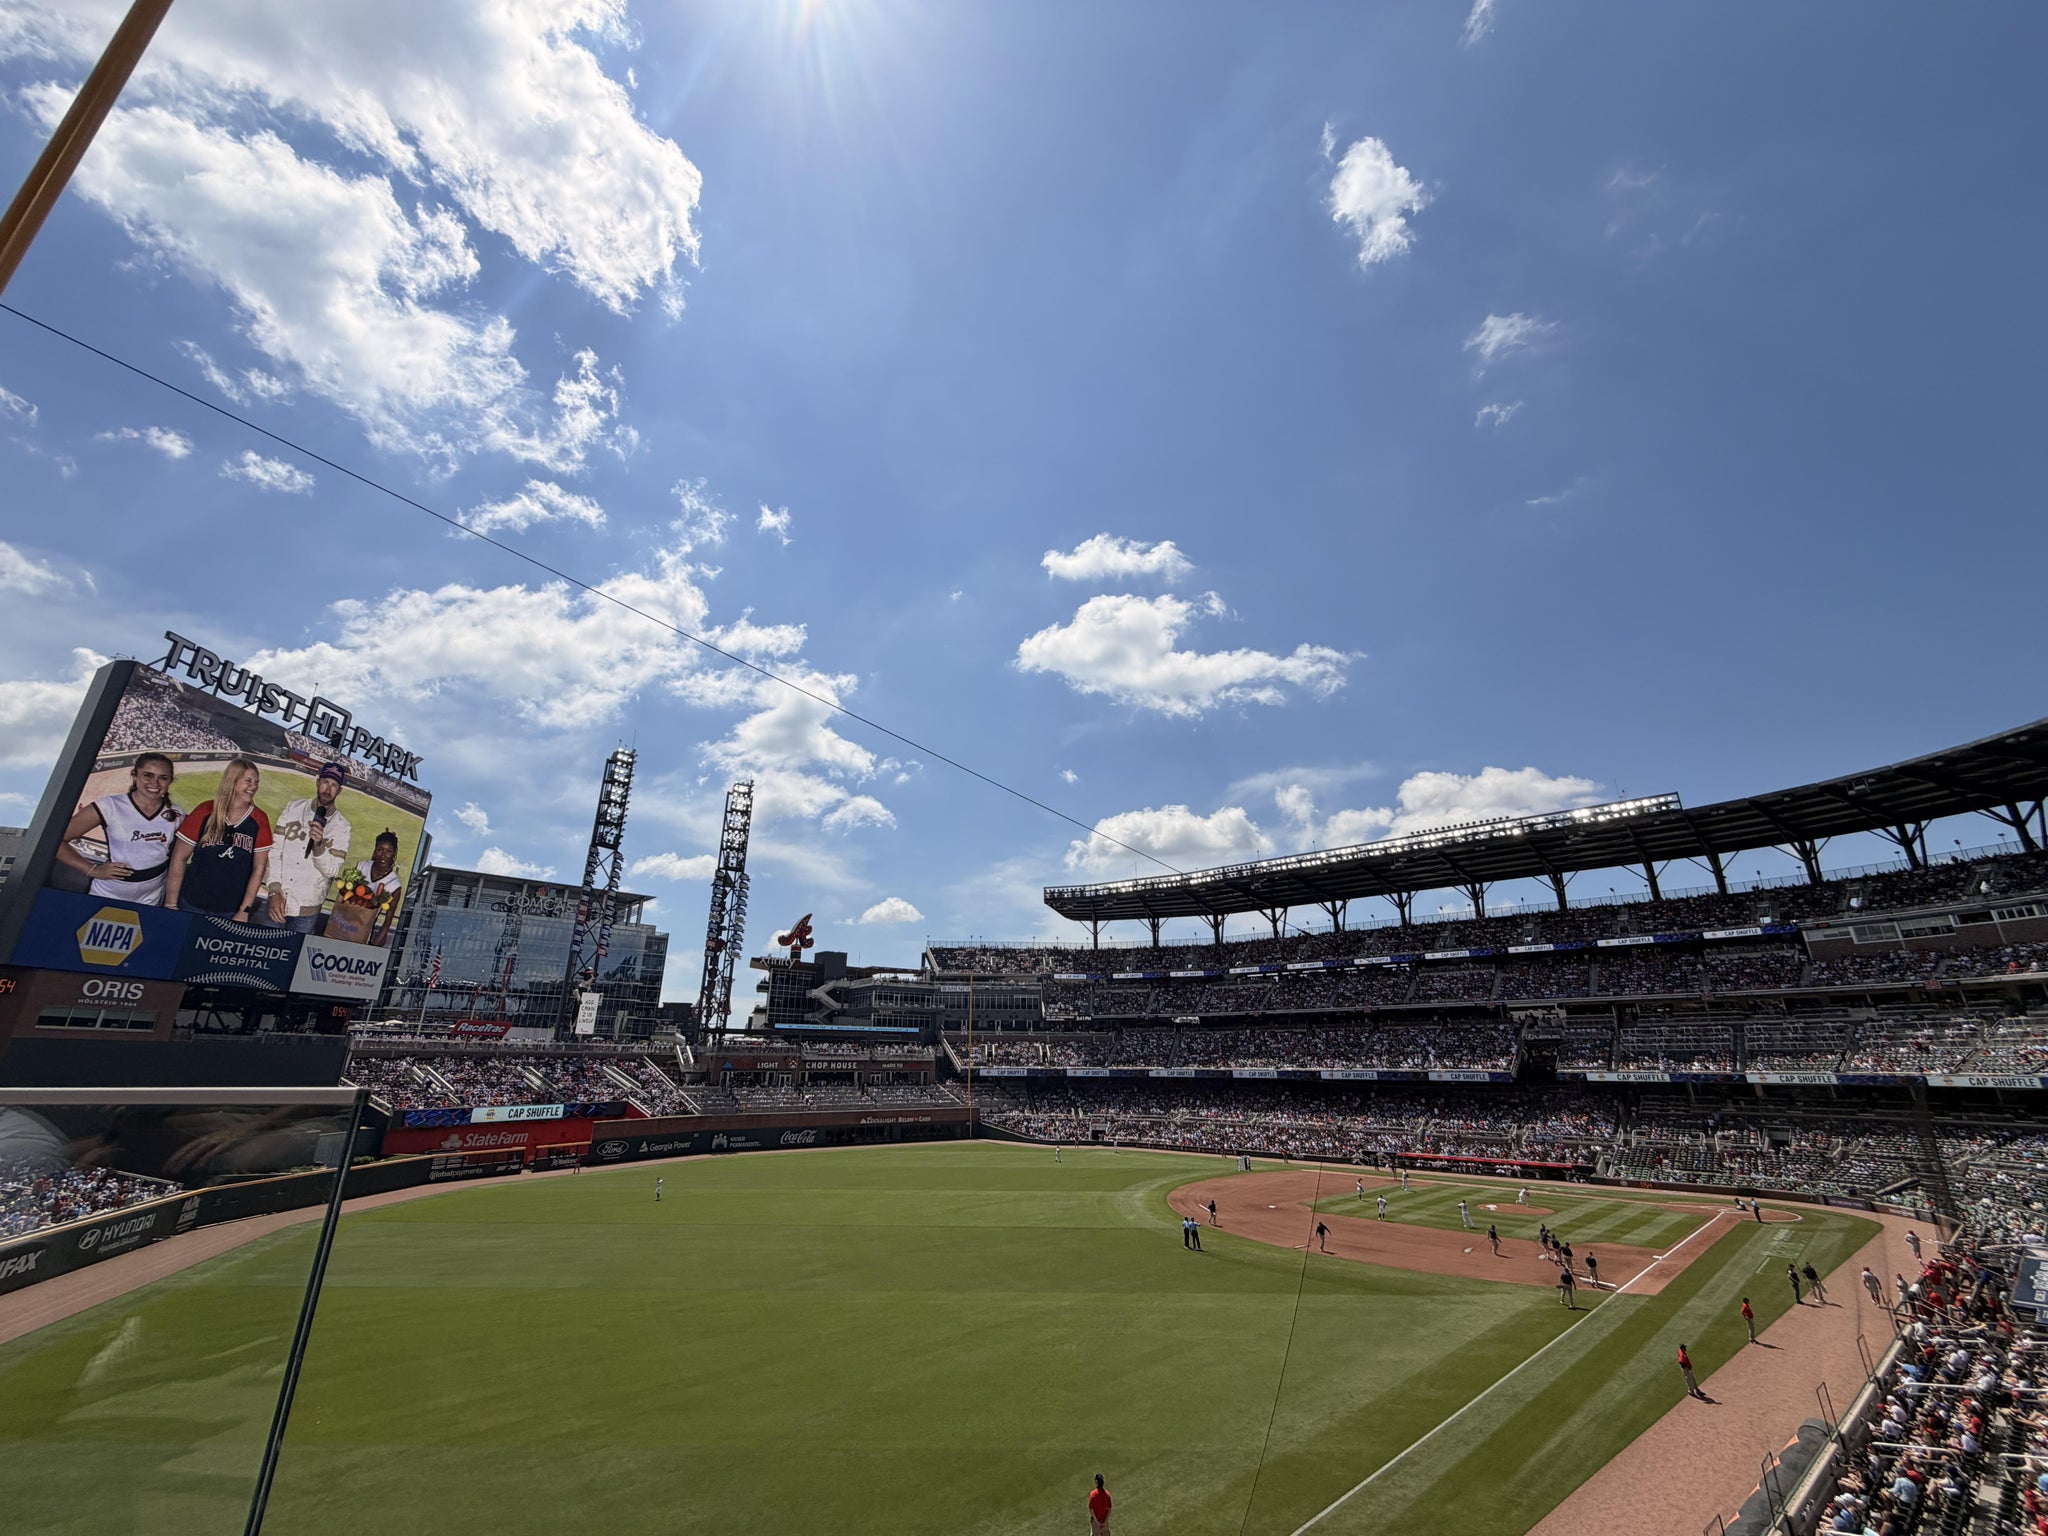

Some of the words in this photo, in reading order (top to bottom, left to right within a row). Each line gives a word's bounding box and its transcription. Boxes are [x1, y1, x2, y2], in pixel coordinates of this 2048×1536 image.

[165, 631, 305, 722] TRUIST
[351, 726, 424, 781] PARK
[285, 820, 335, 848] Brs
[505, 894, 576, 913] COMCAS
[85, 921, 134, 951] NAPA
[1737, 928, 1758, 936] SHUFFLE
[195, 936, 291, 961] NORTHSIDE
[209, 954, 270, 970] HOSPITAL
[311, 952, 383, 976] COOLRAY
[82, 979, 145, 1000] ORIS
[78, 998, 118, 1006] HOLSTEIN
[457, 1022, 506, 1033] RaceTrac
[1779, 1074, 1794, 1083] CAP
[1796, 1075, 1833, 1084] SHUFFLE
[1969, 1076, 1991, 1086] CAP
[1993, 1077, 2036, 1088] SHUFFLE
[508, 1108, 524, 1118] CAP
[526, 1106, 560, 1118] SHUFFLE
[780, 1129, 818, 1145] Coca-Cola
[601, 1142, 624, 1154] Ford
[650, 1143, 672, 1152] Georgia
[673, 1141, 691, 1149] Power
[102, 1213, 156, 1242] HYUNDAI
